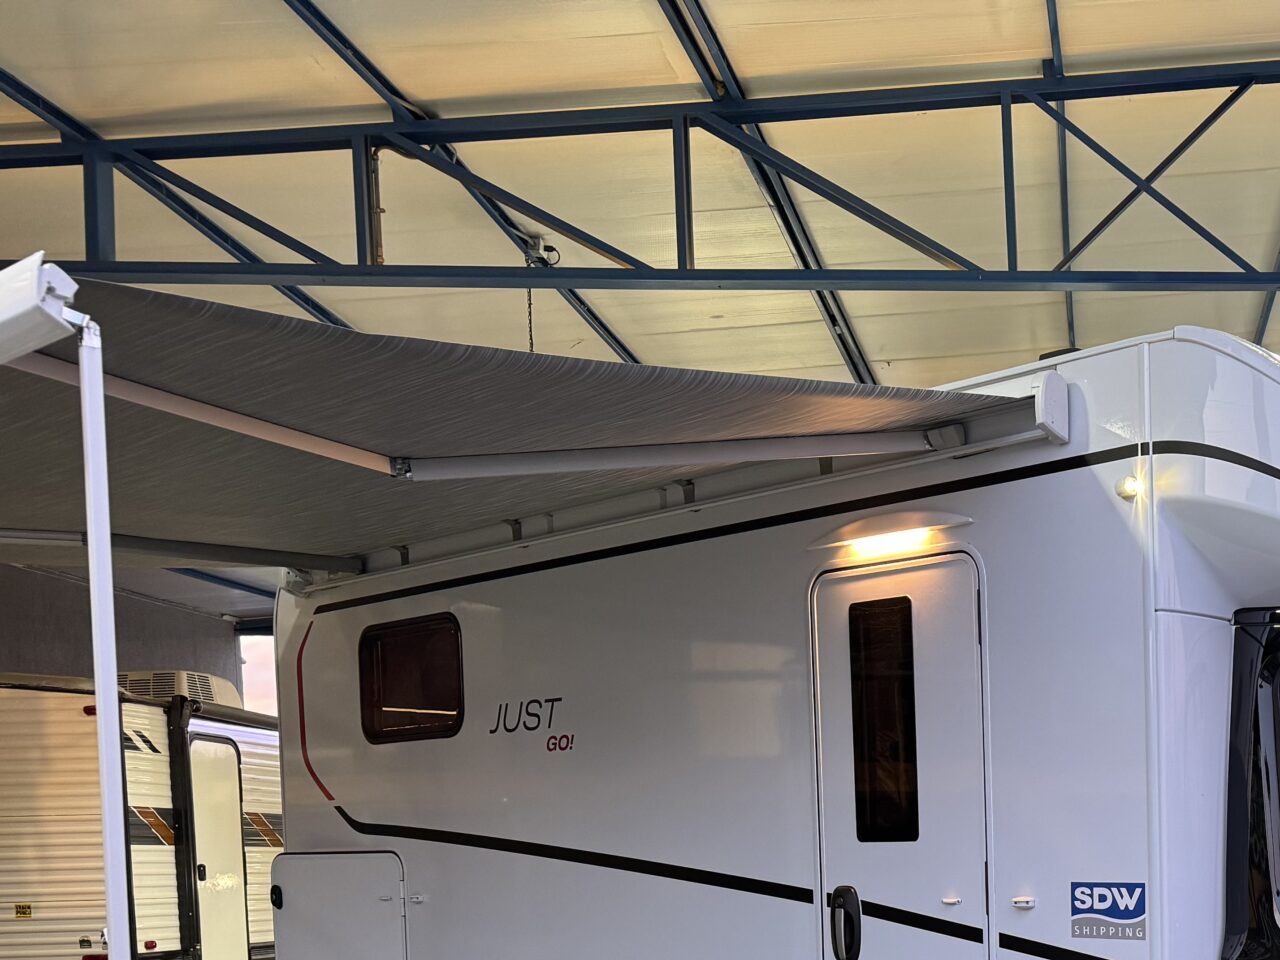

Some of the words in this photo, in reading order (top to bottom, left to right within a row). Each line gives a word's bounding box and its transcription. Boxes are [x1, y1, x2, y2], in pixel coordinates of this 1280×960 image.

[489, 697, 562, 734] JUST
[546, 734, 575, 752] GO!
[1074, 886, 1143, 911] SDW
[1074, 925, 1143, 938] SHIPPING
